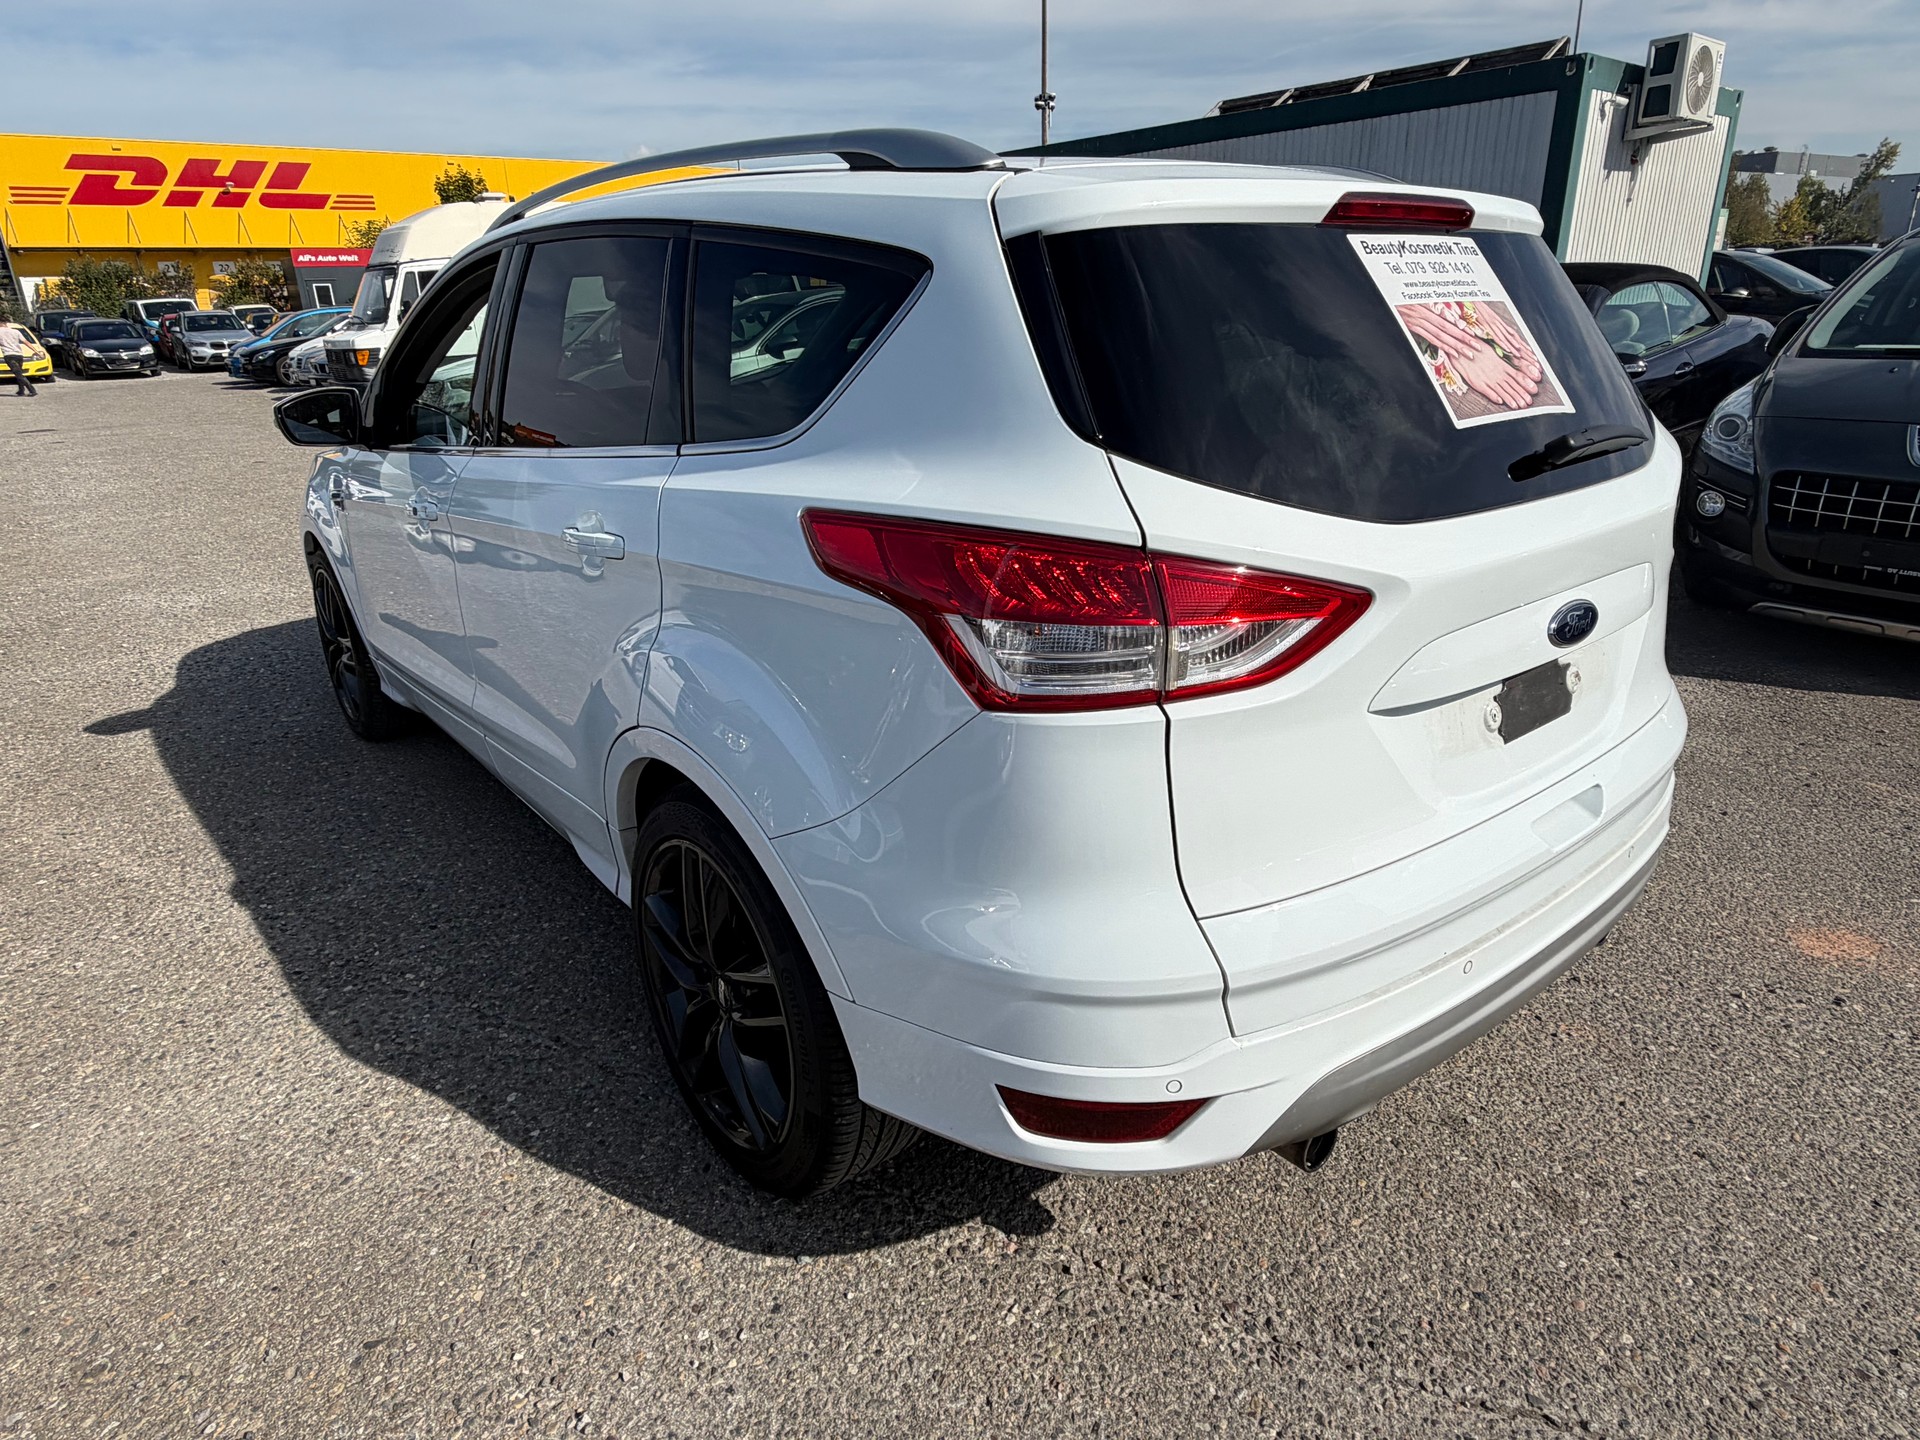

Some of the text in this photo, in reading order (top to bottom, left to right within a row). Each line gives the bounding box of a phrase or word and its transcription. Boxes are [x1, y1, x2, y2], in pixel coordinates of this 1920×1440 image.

[64, 153, 332, 209] DHL
[1360, 240, 1479, 257] BeautyKosmetik Tina
[1383, 261, 1475, 274] Tel. 079 928 14 81
[1565, 609, 1592, 638] Ford
